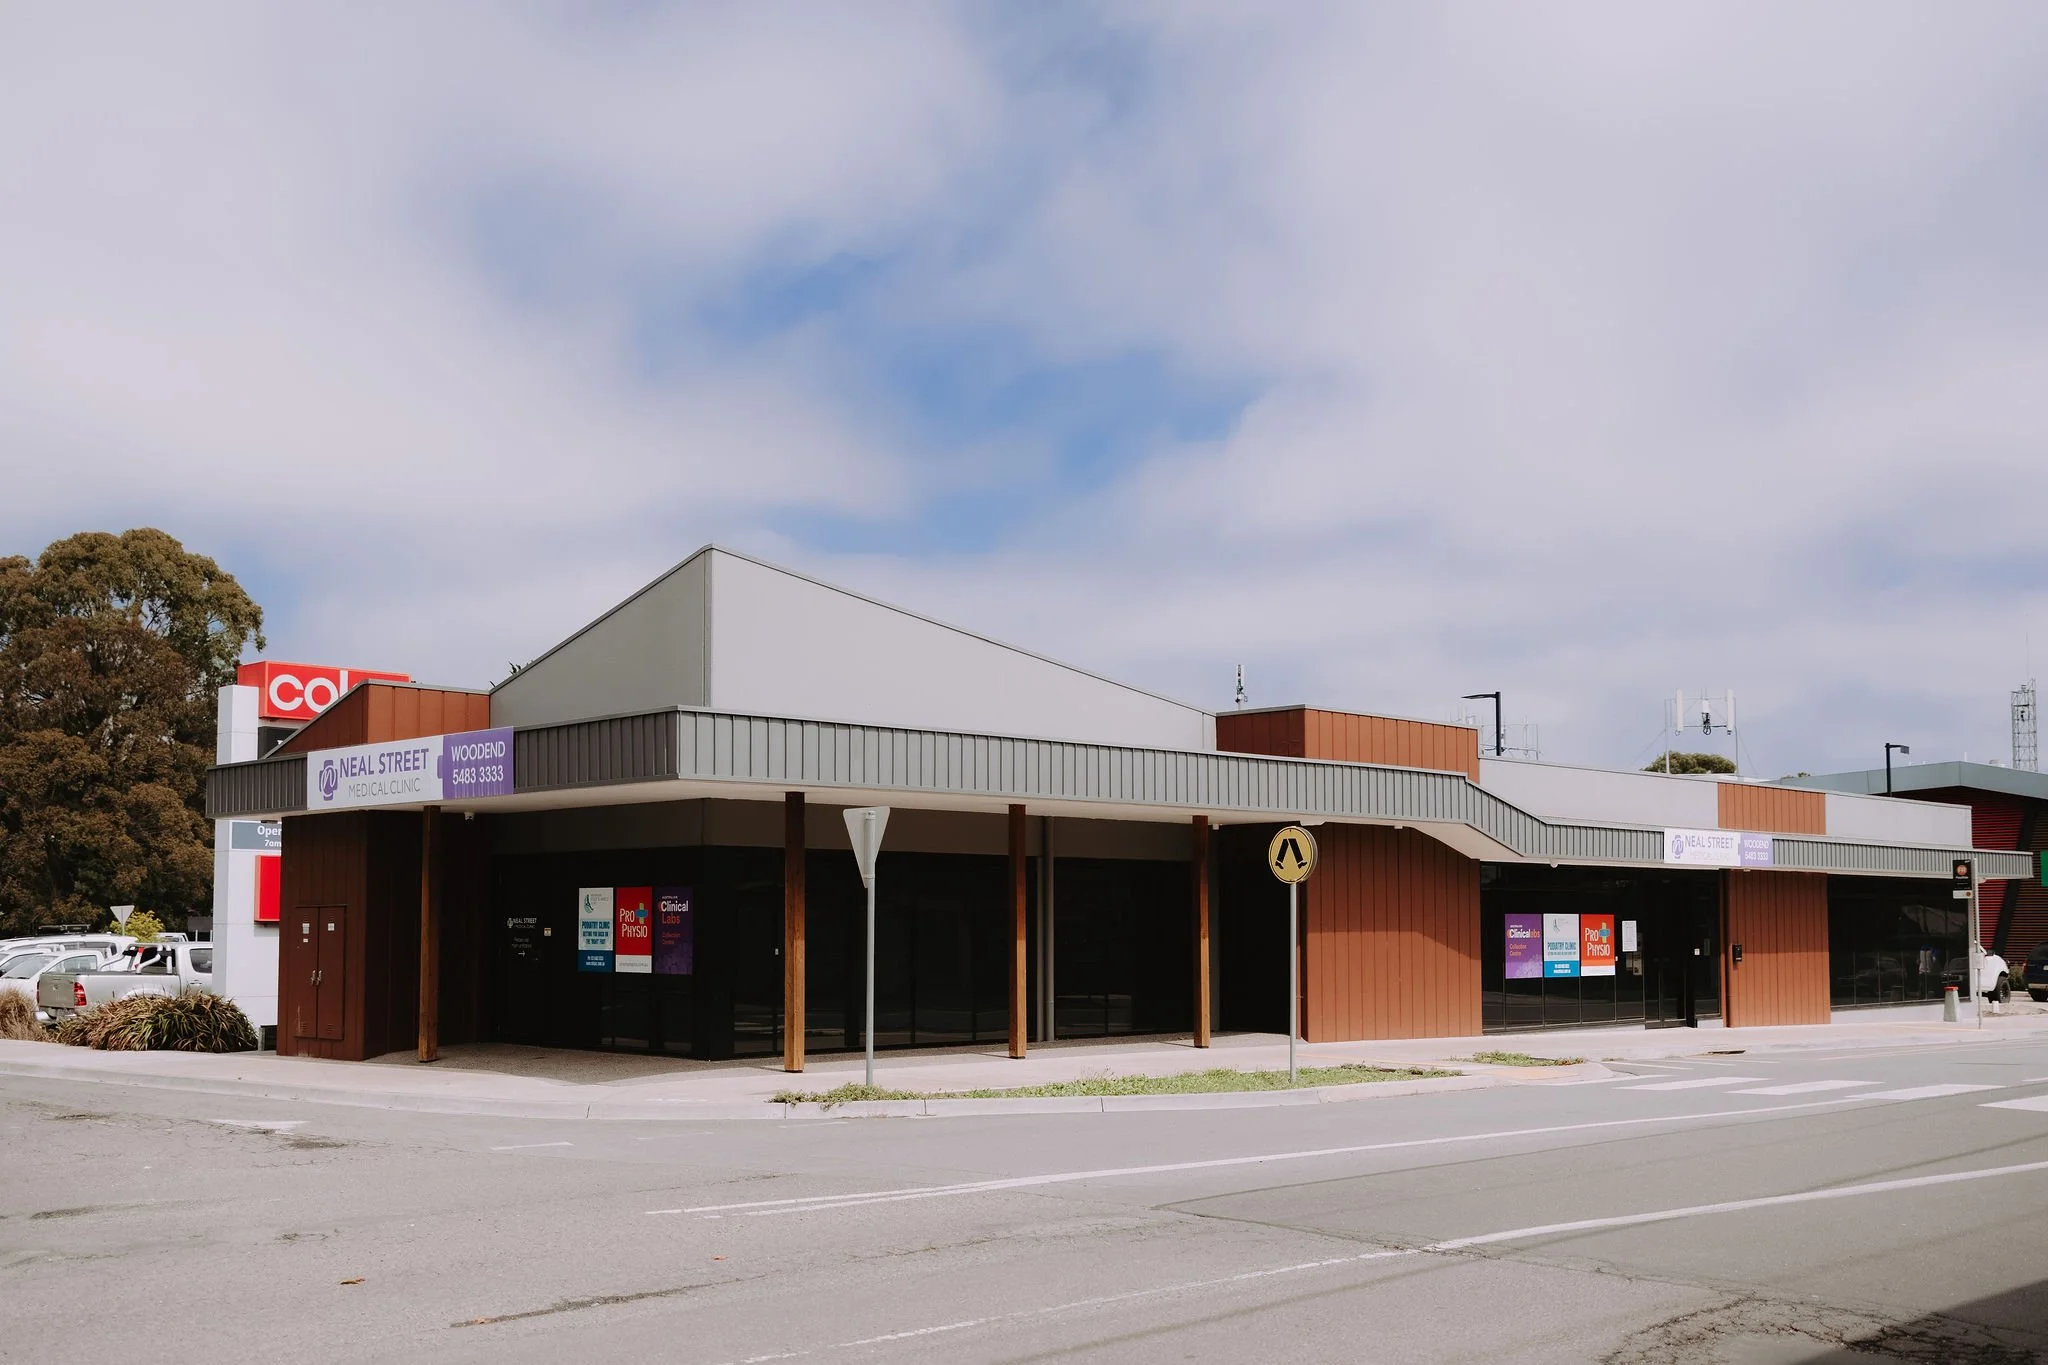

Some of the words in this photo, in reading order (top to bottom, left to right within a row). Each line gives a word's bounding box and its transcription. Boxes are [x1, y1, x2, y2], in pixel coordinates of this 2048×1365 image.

[269, 670, 360, 713] col
[451, 741, 506, 762] WOODEND
[340, 754, 375, 778] NEAL
[379, 748, 429, 775] STREET
[452, 767, 477, 785] 5483
[479, 765, 504, 783] 3333
[348, 780, 389, 798] MEDICAL
[389, 778, 421, 795] CLINIC
[1685, 835, 1705, 848] NEAL
[1708, 836, 1734, 849] STREET
[660, 899, 689, 912] Clinical
[619, 908, 635, 923] PRO
[662, 913, 681, 924] Labs
[621, 923, 648, 938] PHYSIO
[1585, 927, 1598, 942] PRO
[1587, 943, 1610, 957] PHYSIO
